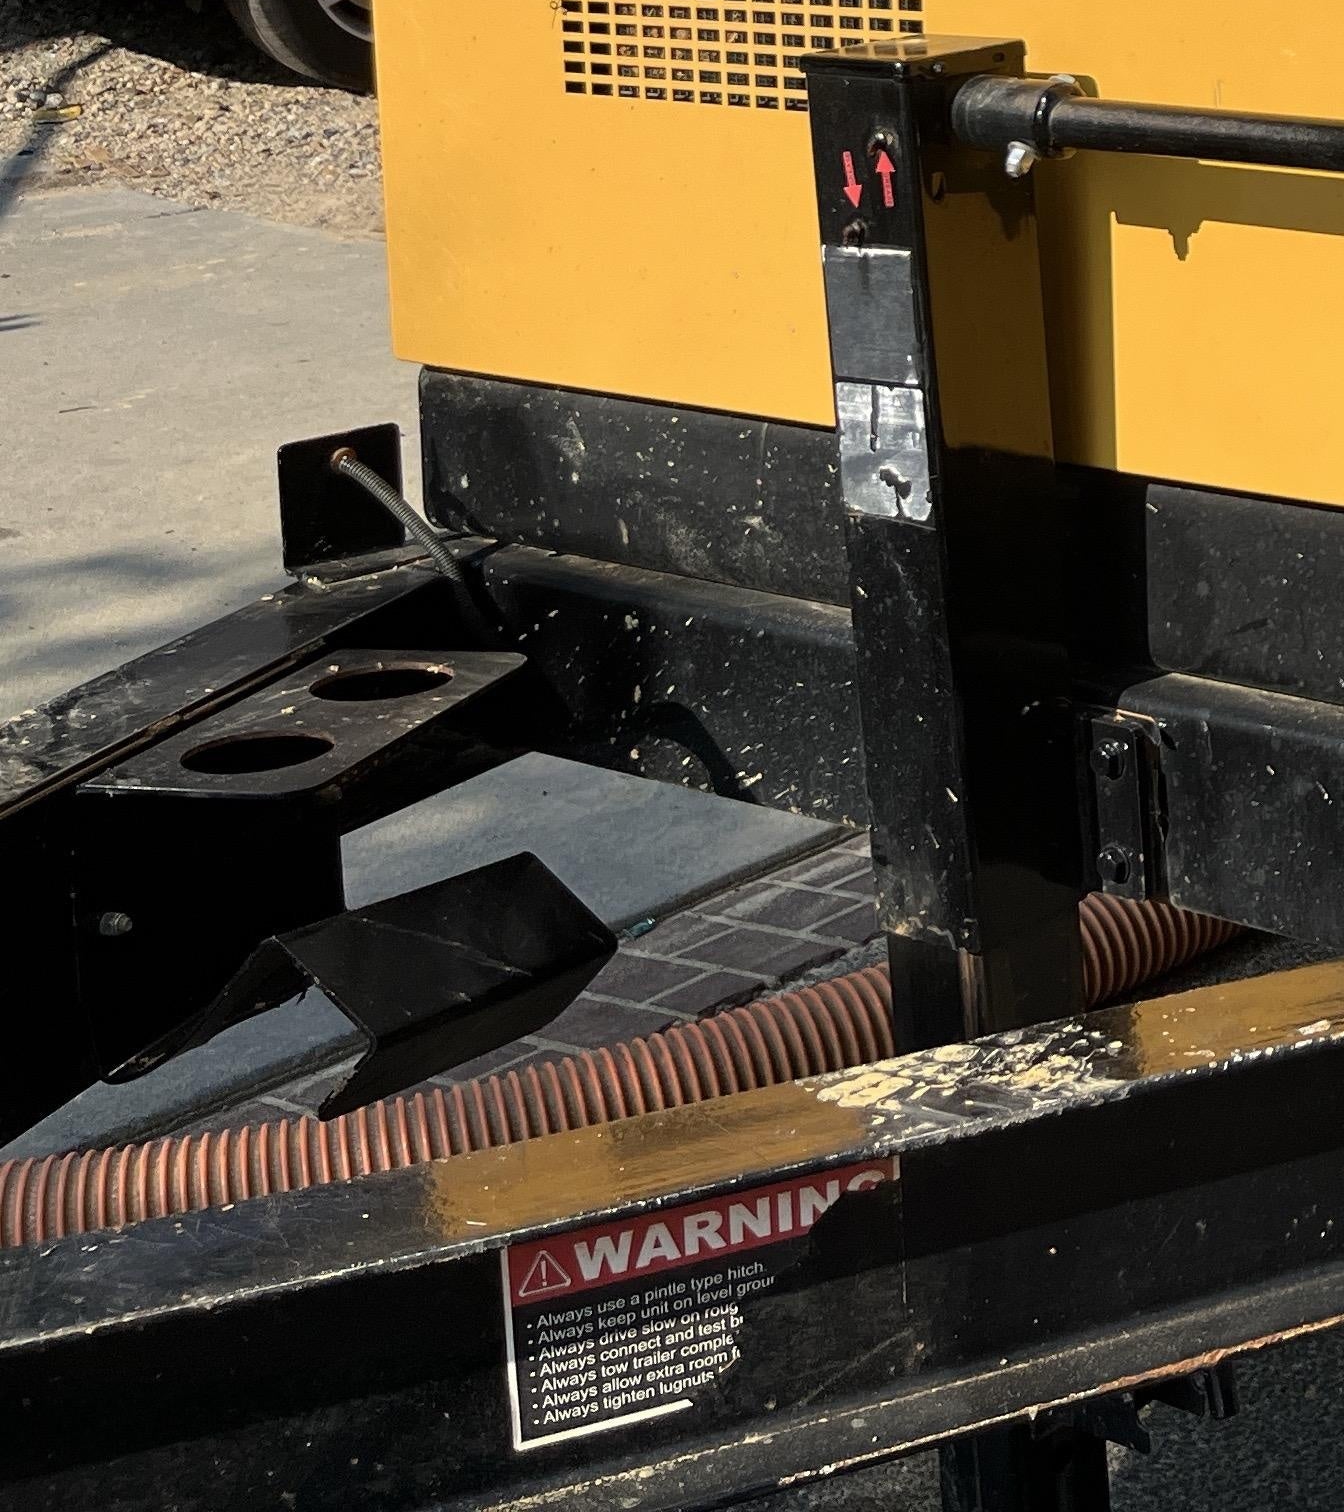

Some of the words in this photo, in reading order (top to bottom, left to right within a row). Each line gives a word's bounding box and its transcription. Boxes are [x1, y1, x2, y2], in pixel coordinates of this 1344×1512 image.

[537, 1307, 593, 1330] Always
[598, 1298, 626, 1314] use
[631, 1295, 640, 1306] a
[646, 1282, 686, 1305] pintle
[691, 1274, 723, 1294] type
[538, 1322, 594, 1345] Always
[598, 1313, 636, 1333] keep
[642, 1303, 669, 1319] unit
[675, 1298, 693, 1311] on
[697, 1287, 732, 1305] level
[539, 1339, 595, 1362] Always
[599, 1328, 637, 1345] drive
[642, 1319, 677, 1336] slow
[681, 1312, 701, 1325] on
[540, 1355, 596, 1378] Always
[600, 1336, 661, 1361] connect
[665, 1326, 694, 1345] and
[699, 1319, 726, 1336] test
[541, 1370, 597, 1394] Always
[601, 1361, 629, 1379] tow
[633, 1348, 675, 1370] trailer
[680, 1331, 740, 1358] comple
[542, 1386, 598, 1410] Always
[602, 1373, 643, 1394] allow
[646, 1364, 685, 1382] extra
[689, 1353, 728, 1371] room
[543, 1402, 599, 1426] Always
[603, 1387, 655, 1411] tighten
[660, 1370, 715, 1394] lugnuts
